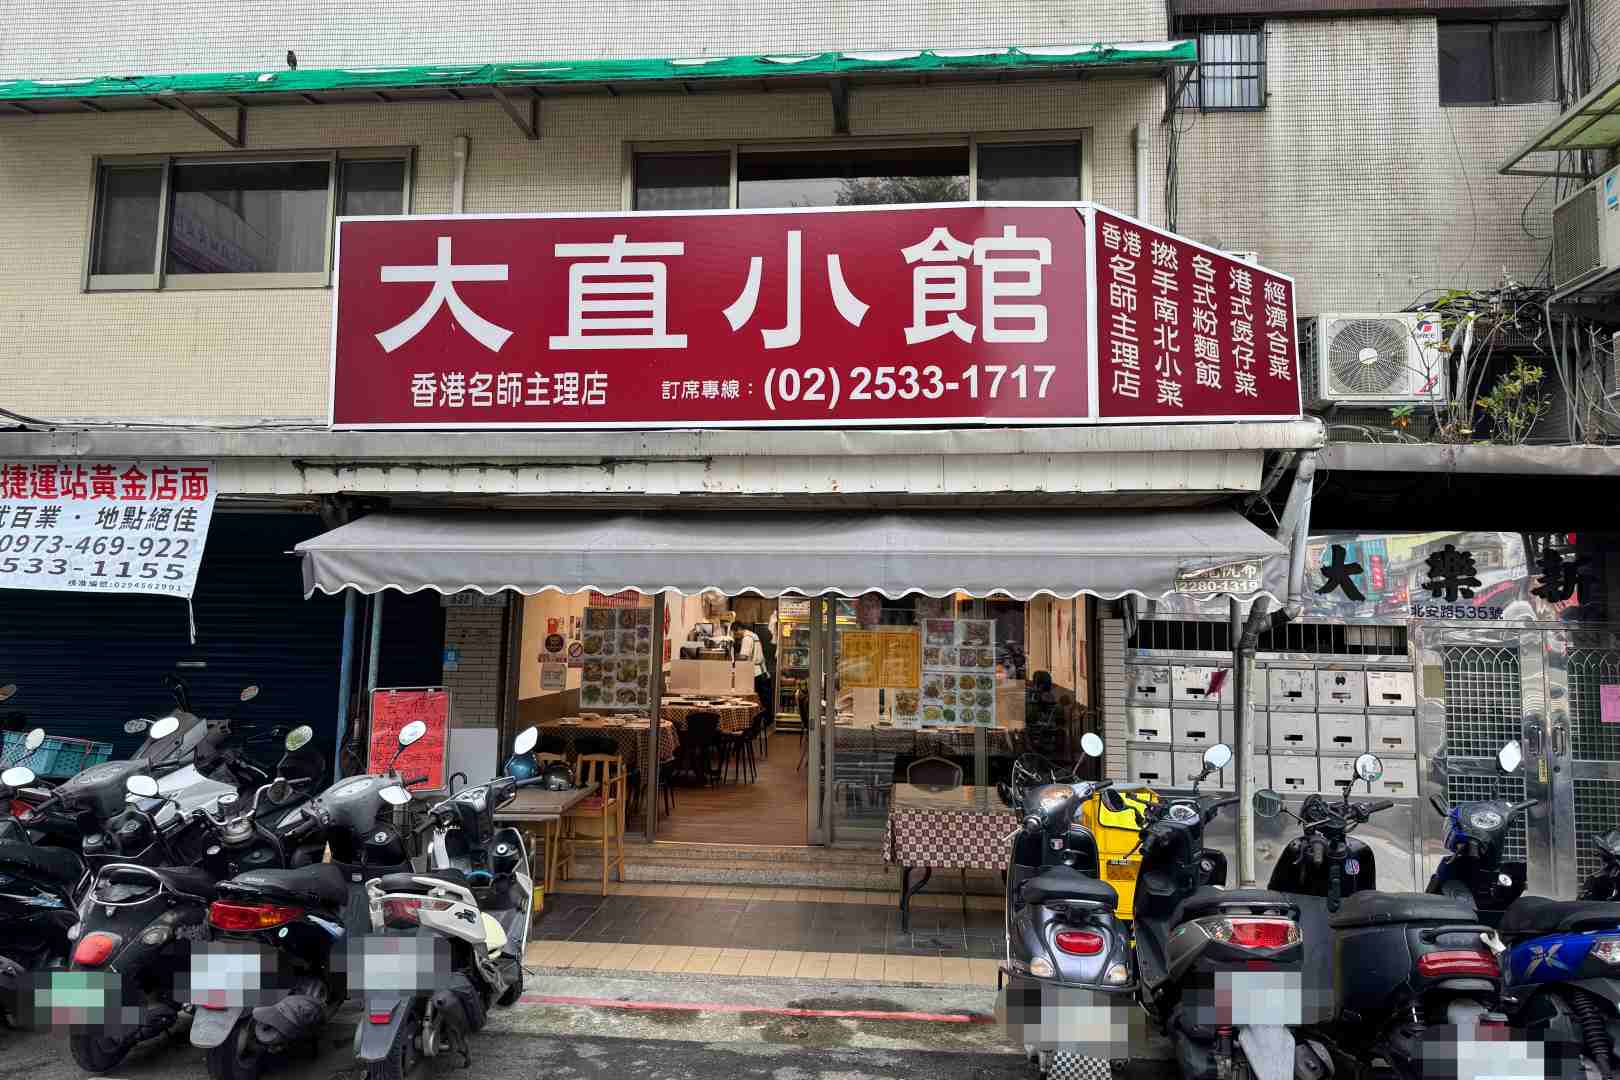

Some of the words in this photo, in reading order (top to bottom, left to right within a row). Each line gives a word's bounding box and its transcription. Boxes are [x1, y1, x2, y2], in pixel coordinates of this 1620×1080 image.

[374, 225, 1052, 353] 大直小館
[1102, 222, 1142, 399] 香港名師主理店
[1151, 239, 1184, 408] 撚手南北小菜
[1191, 254, 1222, 390] 各式粉麵飯
[1229, 266, 1258, 398] 港式煲仔菜
[1263, 278, 1292, 381] 經濟合菜
[411, 371, 608, 408] 香港名師主理店
[763, 367, 841, 411] (02)
[848, 364, 1056, 401] 2533-1717
[0, 463, 209, 501] 捷運站黃金店面
